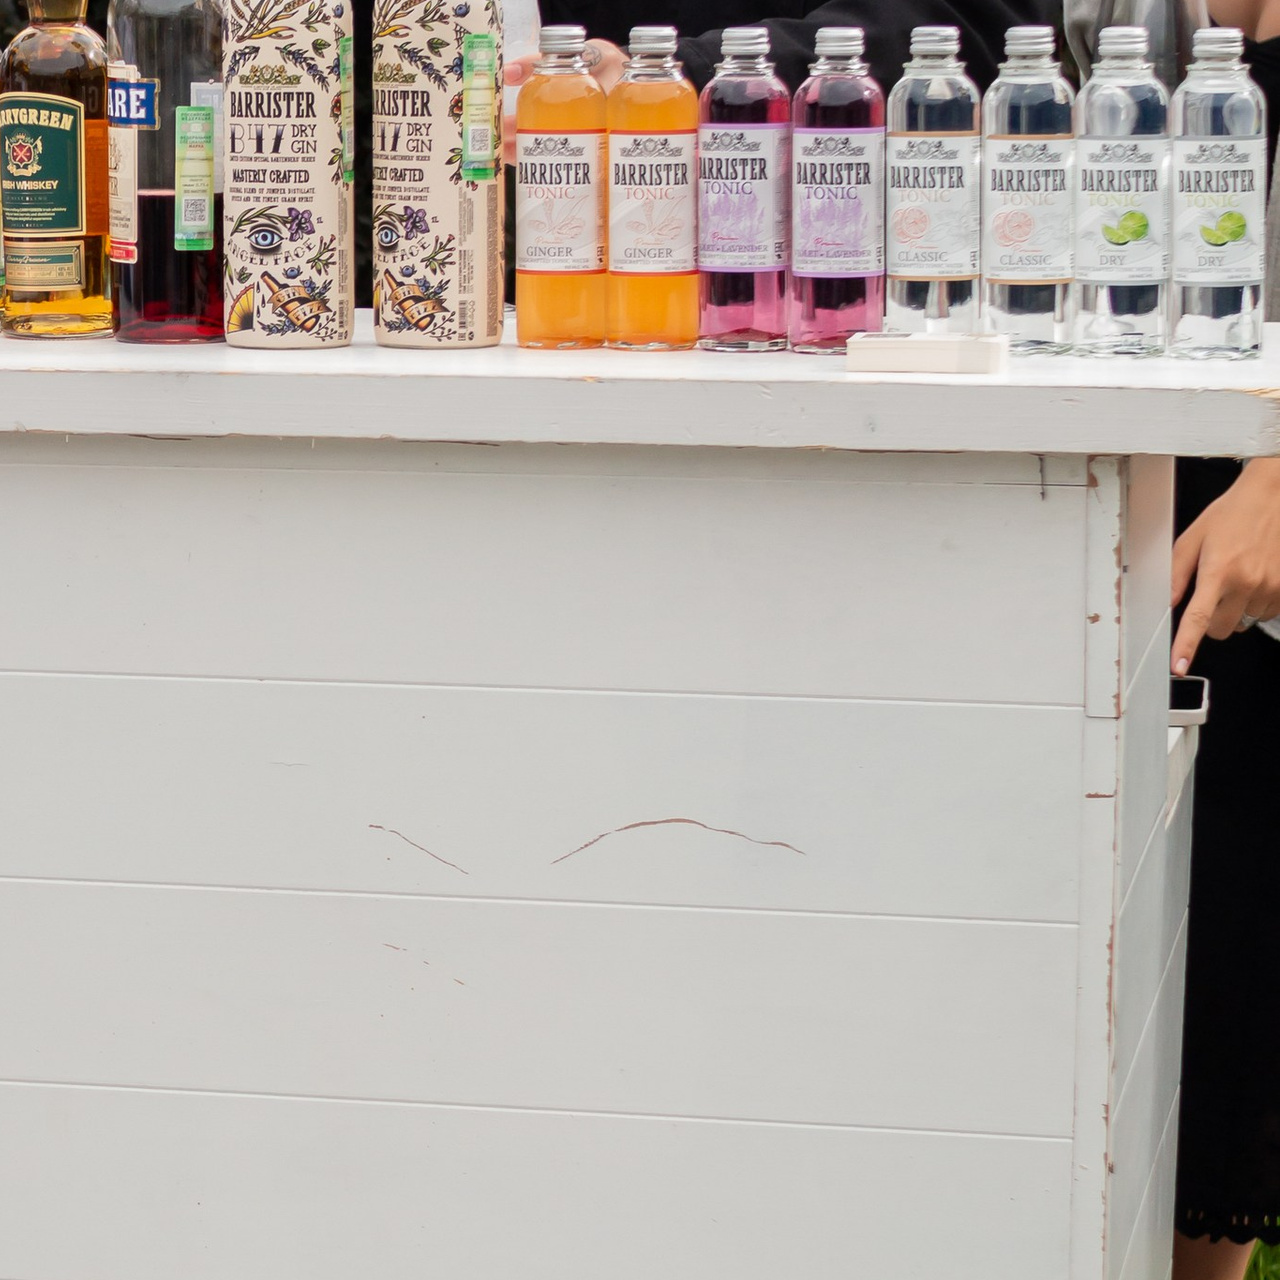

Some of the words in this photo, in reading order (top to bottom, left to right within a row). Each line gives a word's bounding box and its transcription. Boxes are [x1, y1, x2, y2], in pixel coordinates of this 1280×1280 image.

[230, 91, 317, 118] BARRISTER
[373, 89, 432, 117] RRISTER
[229, 122, 287, 154] B47
[291, 123, 317, 138] DRY
[373, 121, 403, 152] 47
[406, 122, 432, 136] DRY
[290, 139, 318, 154] GIN
[406, 138, 433, 153] GIN
[232, 168, 267, 183] MASTERLY
[269, 169, 310, 184] CRAFTED
[389, 167, 424, 182] CRAFTED
[518, 162, 591, 185] BARRISTER
[614, 163, 688, 186] BARRISTER
[796, 162, 871, 185] BARRISTER
[890, 166, 965, 189] BARRISTER
[991, 169, 1066, 192] BARRISTER
[1081, 169, 1158, 192] BARRISTER
[16, 180, 59, 190] WHISKEY
[704, 181, 753, 195] TONIC
[1178, 169, 1255, 193] BARRISTER
[526, 186, 575, 199] TONIC
[624, 187, 675, 200] TONIC
[805, 186, 858, 200] TONIC
[897, 189, 952, 203] TONIC
[1000, 192, 1056, 206] TONIC
[1087, 193, 1143, 207] TONIC
[1185, 194, 1241, 208] TONIC
[227, 238, 269, 266] ANGEL
[274, 237, 317, 266] FACE
[392, 236, 431, 264] FACE
[526, 246, 573, 257] GINGER
[624, 247, 673, 259] GINGER
[721, 244, 768, 253] LAVENDER
[825, 249, 872, 259] LAVENDER
[897, 251, 949, 263] CLASSIC
[999, 254, 1053, 266] CLASSIC
[1099, 255, 1127, 266] DRY
[1197, 256, 1226, 267] DRY
